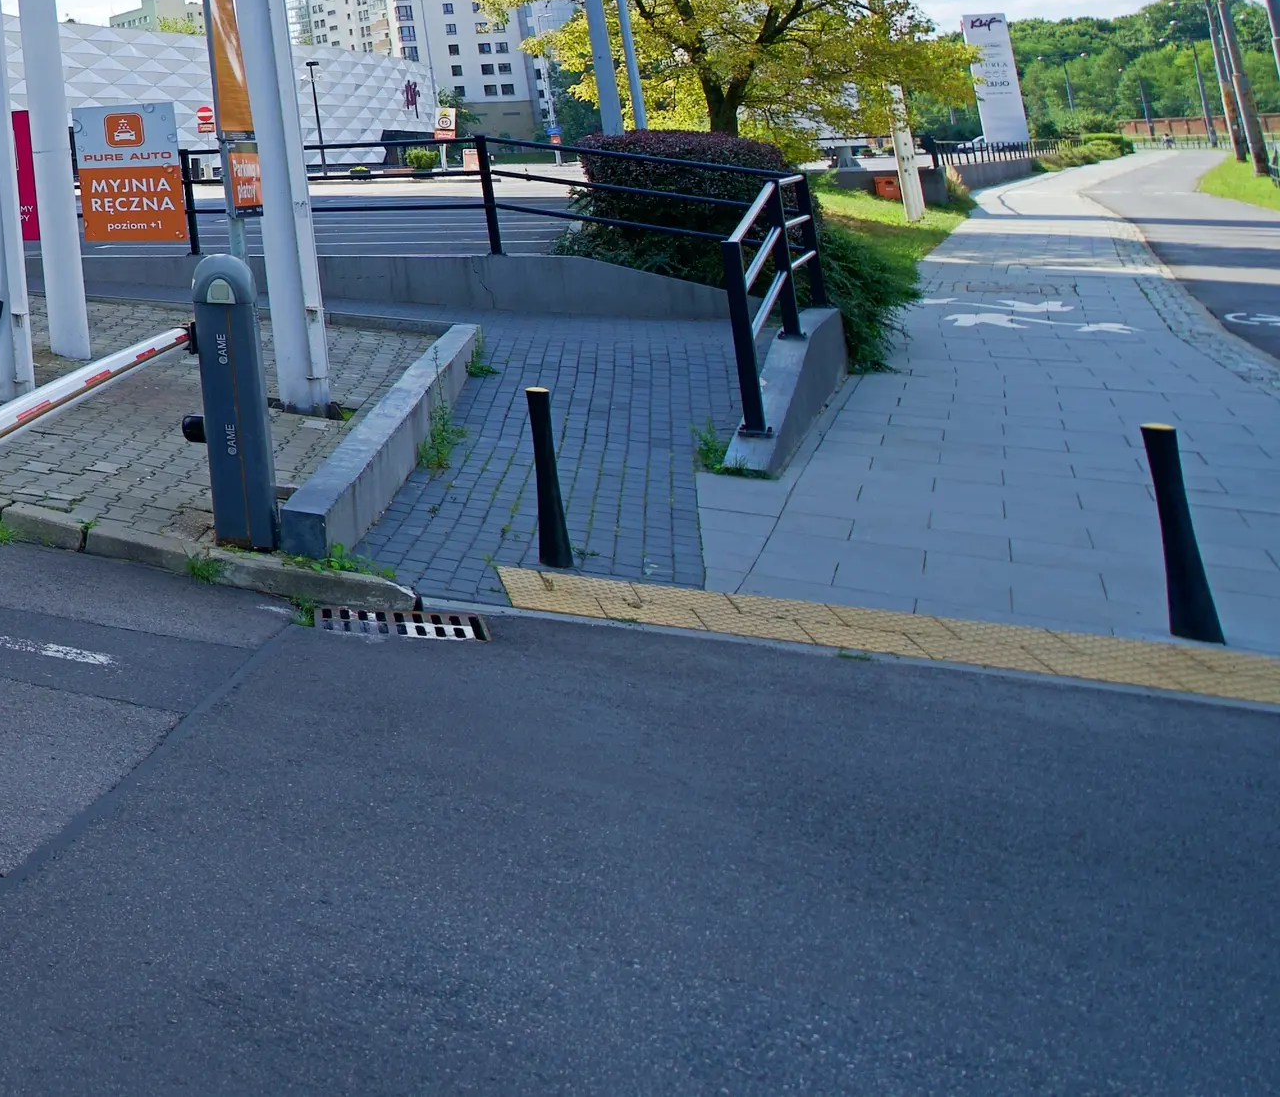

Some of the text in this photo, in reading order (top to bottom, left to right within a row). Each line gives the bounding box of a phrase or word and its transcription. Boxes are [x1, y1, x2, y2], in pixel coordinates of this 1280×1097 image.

[970, 17, 1002, 31] Klif
[83, 151, 172, 163] PURE AUTO
[91, 177, 172, 194] MYJNIA
[91, 196, 175, 214] RĘCZNA
[107, 221, 162, 232] poziom +1
